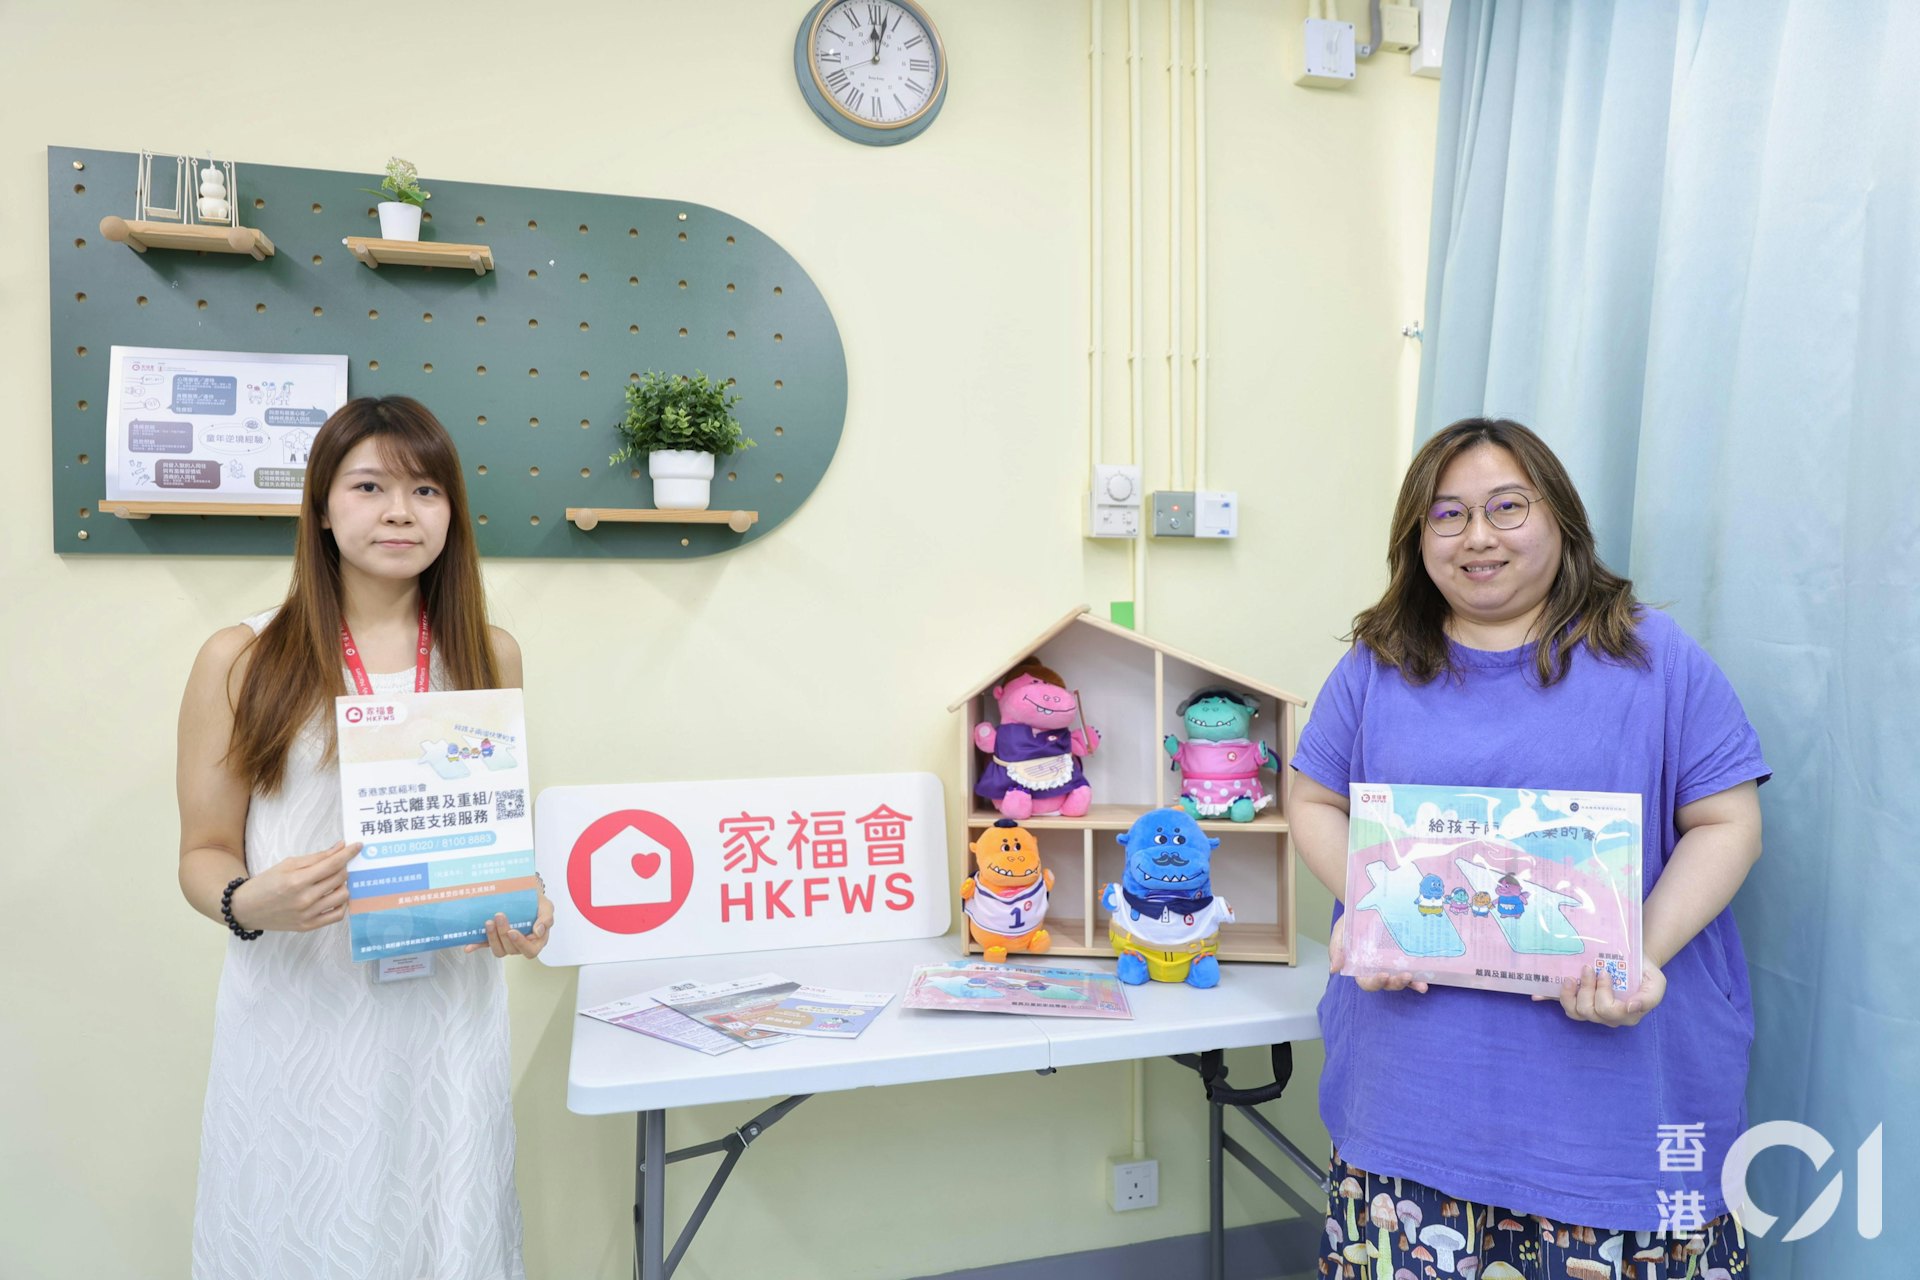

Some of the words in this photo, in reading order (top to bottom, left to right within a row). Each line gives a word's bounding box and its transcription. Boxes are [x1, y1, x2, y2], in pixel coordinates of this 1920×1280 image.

[358, 783, 427, 798] 香港家庭福利會
[360, 809, 489, 836] 再婚家庭支援服務
[382, 843, 407, 855] 8100
[409, 840, 434, 851] 8020
[442, 836, 466, 847] 8100
[468, 833, 492, 845] 8883
[719, 803, 913, 874] 家福會
[720, 872, 915, 923] HKFWS
[1009, 907, 1025, 929] 1
